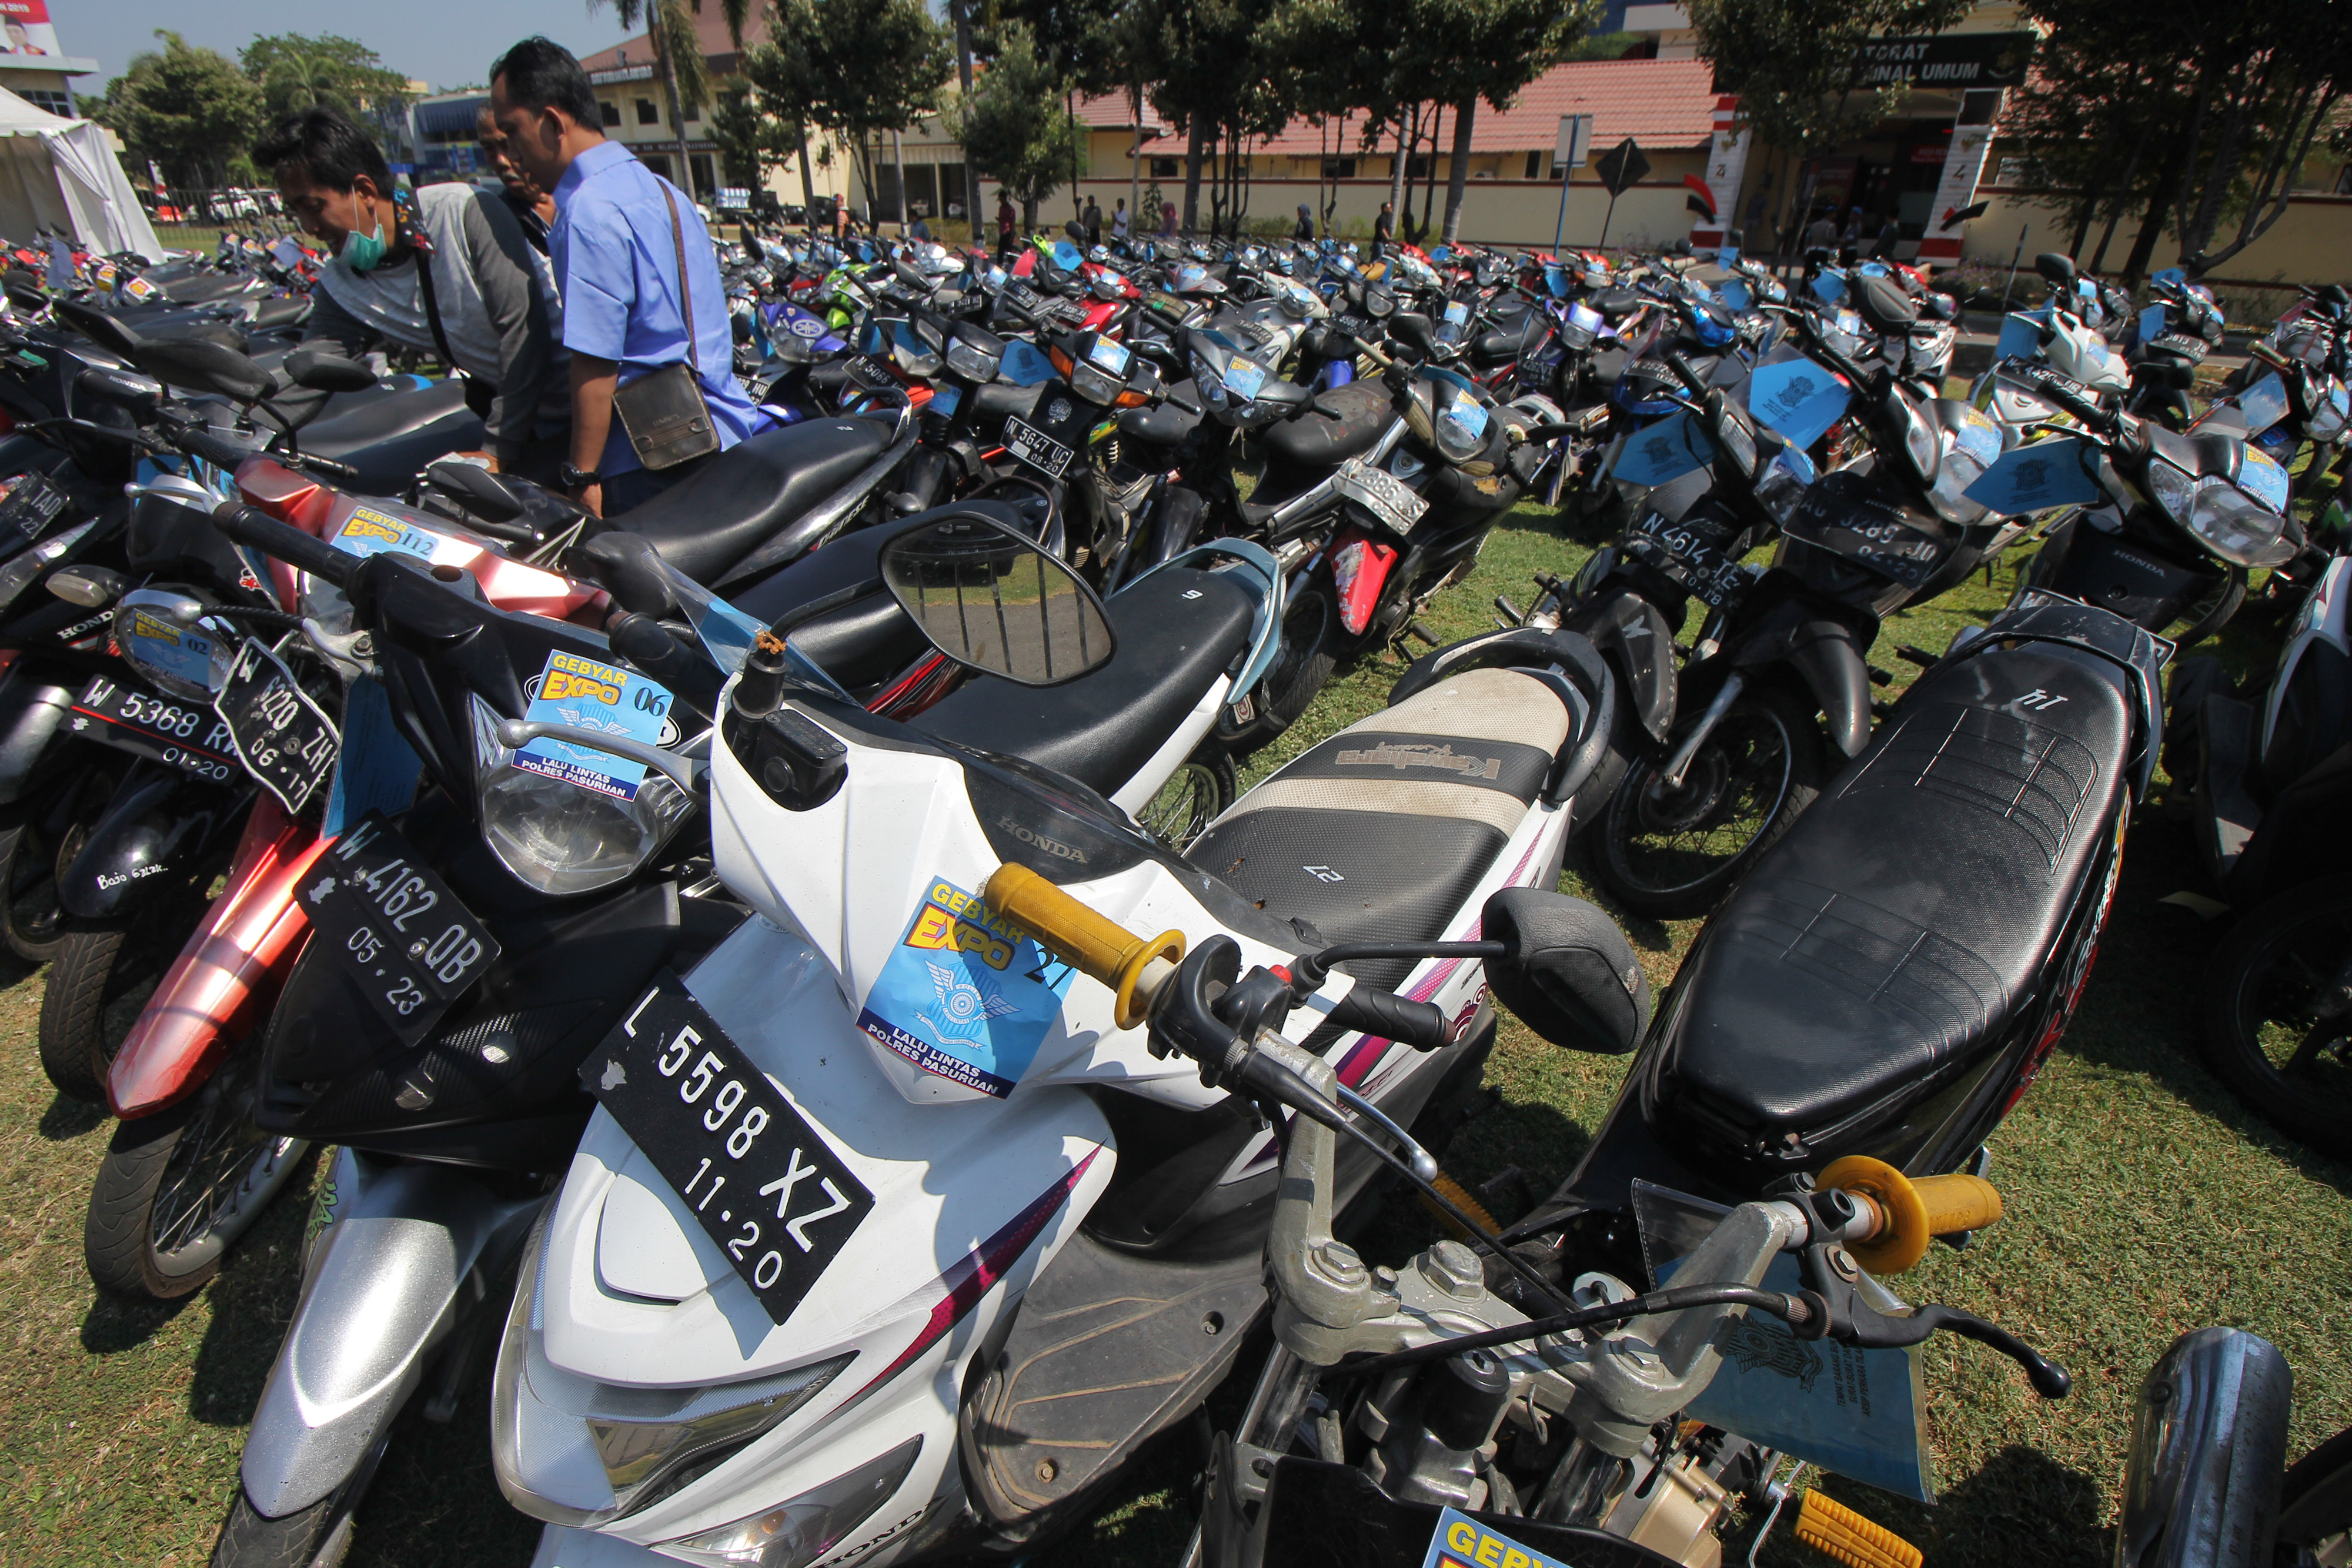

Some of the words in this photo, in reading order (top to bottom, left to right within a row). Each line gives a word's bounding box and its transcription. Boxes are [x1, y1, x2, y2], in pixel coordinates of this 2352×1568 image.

[1921, 63, 1980, 79] UMUM
[109, 375, 147, 392] HONDA
[856, 356, 868, 366] N
[865, 364, 890, 385] 5066
[752, 382, 769, 396] HU
[1007, 420, 1018, 434] N
[1019, 428, 1050, 453] 5647
[1051, 446, 1068, 464] UC
[356, 509, 408, 533] GEBYAR
[342, 517, 401, 544] EXPO
[401, 532, 435, 556] 112
[1642, 513, 1664, 534] N
[1662, 527, 1712, 564] 4614
[2113, 550, 2166, 579] HONDA
[57, 610, 116, 640] HOND
[135, 612, 181, 637] GEBYAR
[135, 620, 181, 647] EXPO
[187, 638, 208, 656] 02
[239, 648, 262, 683] W
[553, 655, 628, 687] GEBYAR
[83, 678, 116, 707] W
[119, 692, 200, 737] 5368
[538, 668, 622, 706] EXPO
[634, 687, 670, 717] 06
[522, 760, 563, 777] POLRES
[565, 772, 627, 797] PASURUAN
[542, 757, 569, 771] LALU
[570, 765, 611, 784] LINTAS
[996, 815, 1088, 864] HONDA
[336, 821, 377, 862] W
[366, 859, 438, 932] 4162
[426, 924, 481, 984] QB
[932, 883, 1027, 945] GEBYAR
[903, 900, 1016, 971] EXPO
[1023, 947, 1075, 990] 27
[944, 1008, 953, 1021] LALU
[867, 1023, 920, 1062] POLRES
[922, 1057, 999, 1095] PASURUAN
[892, 1028, 929, 1054] LALU
[931, 1048, 981, 1078] LINTAS
[623, 986, 660, 1038] L
[658, 1025, 770, 1160] 5598
[759, 1148, 851, 1253] XZ
[1829, 1338, 1839, 1353] BUK
[1843, 1347, 1852, 1359] DA
[1855, 1346, 1865, 1363] TILA
[1830, 1354, 1843, 1382] BARANG
[1857, 1366, 1869, 1396] PERKARA
[1835, 1382, 1846, 1407] TEMPAT
[1860, 1396, 1871, 1417] ARSIP
